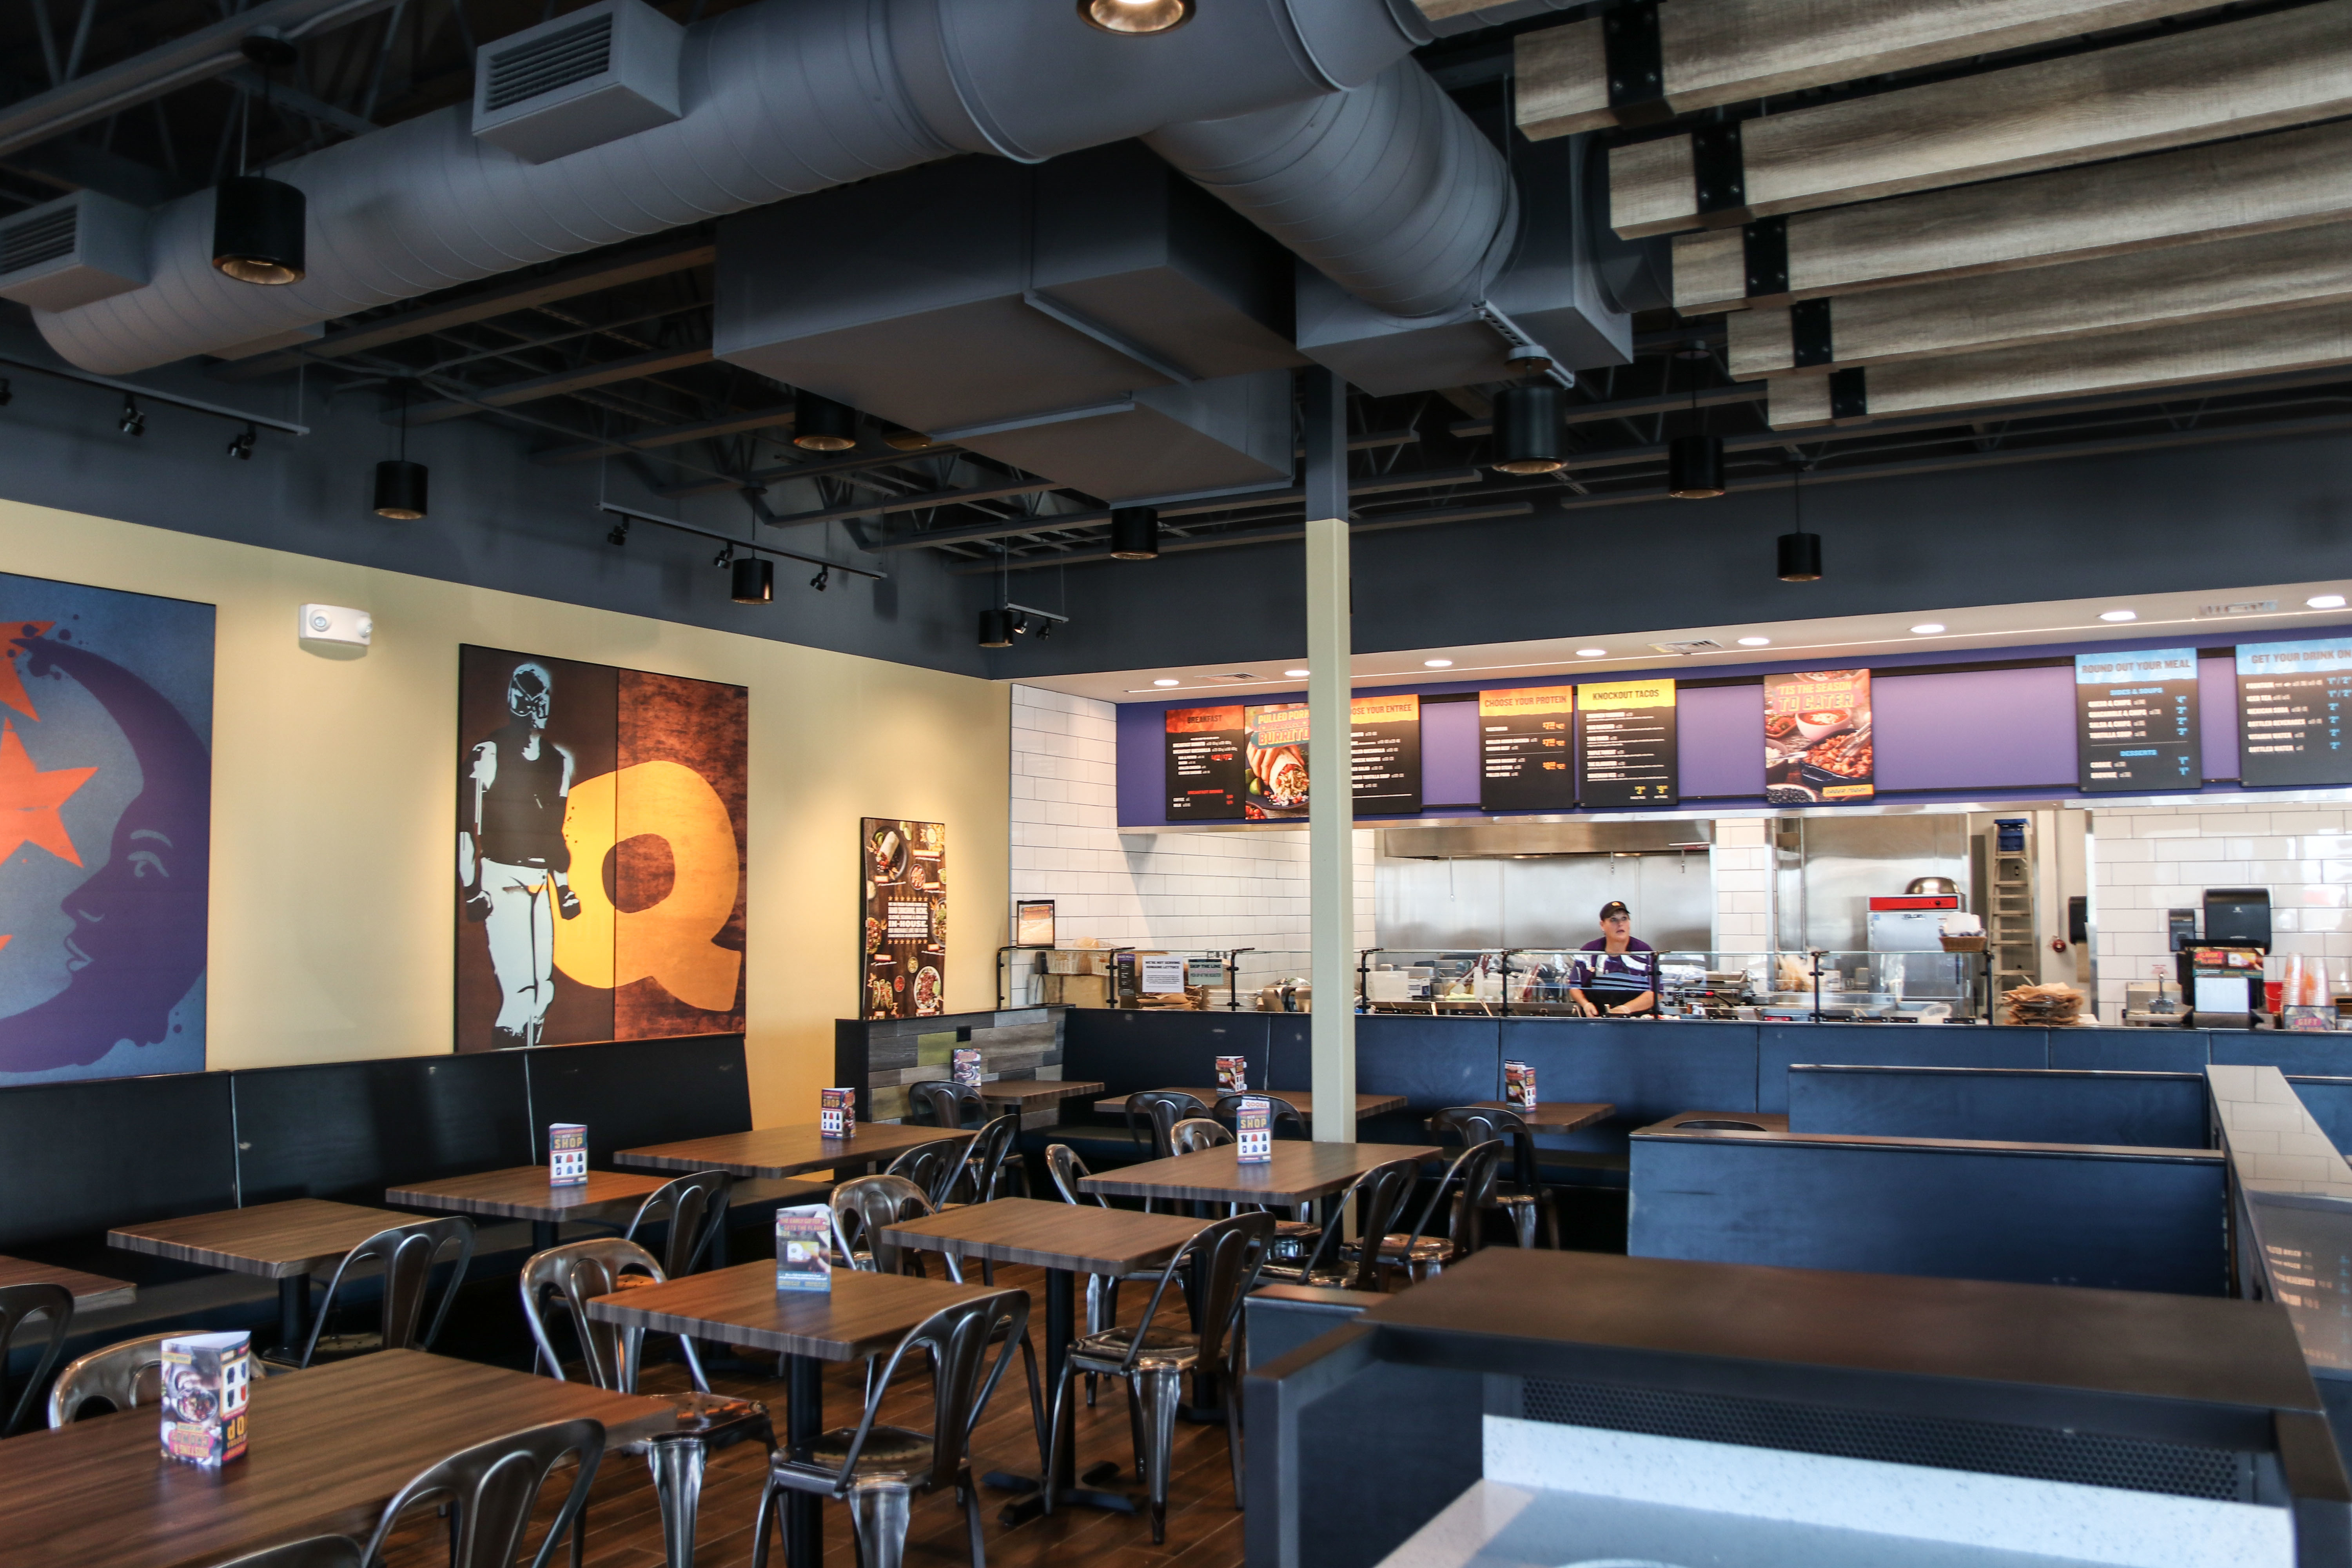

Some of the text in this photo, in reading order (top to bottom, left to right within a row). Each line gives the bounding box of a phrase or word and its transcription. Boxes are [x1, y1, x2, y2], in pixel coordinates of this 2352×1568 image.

[2252, 649, 2351, 663] GET YOUR DRINK ON
[2082, 659, 2190, 673] ROUND OUT YOUR MEAL
[1797, 684, 1815, 693] THE
[1815, 681, 1852, 692] SEASON
[1485, 695, 1567, 707] CHOOSE YOUR PROTEIN
[1593, 690, 1659, 701] KNOCKOUT TACOS
[1779, 693, 1854, 712] TO CATER
[1367, 706, 1384, 714] YOUR
[1187, 715, 1222, 723] BREAKFAST
[1258, 711, 1287, 724] PULLED
[1258, 726, 1310, 746] BURRITO
[1240, 1118, 1267, 1129] SHOP
[554, 1136, 583, 1149] SHOP
